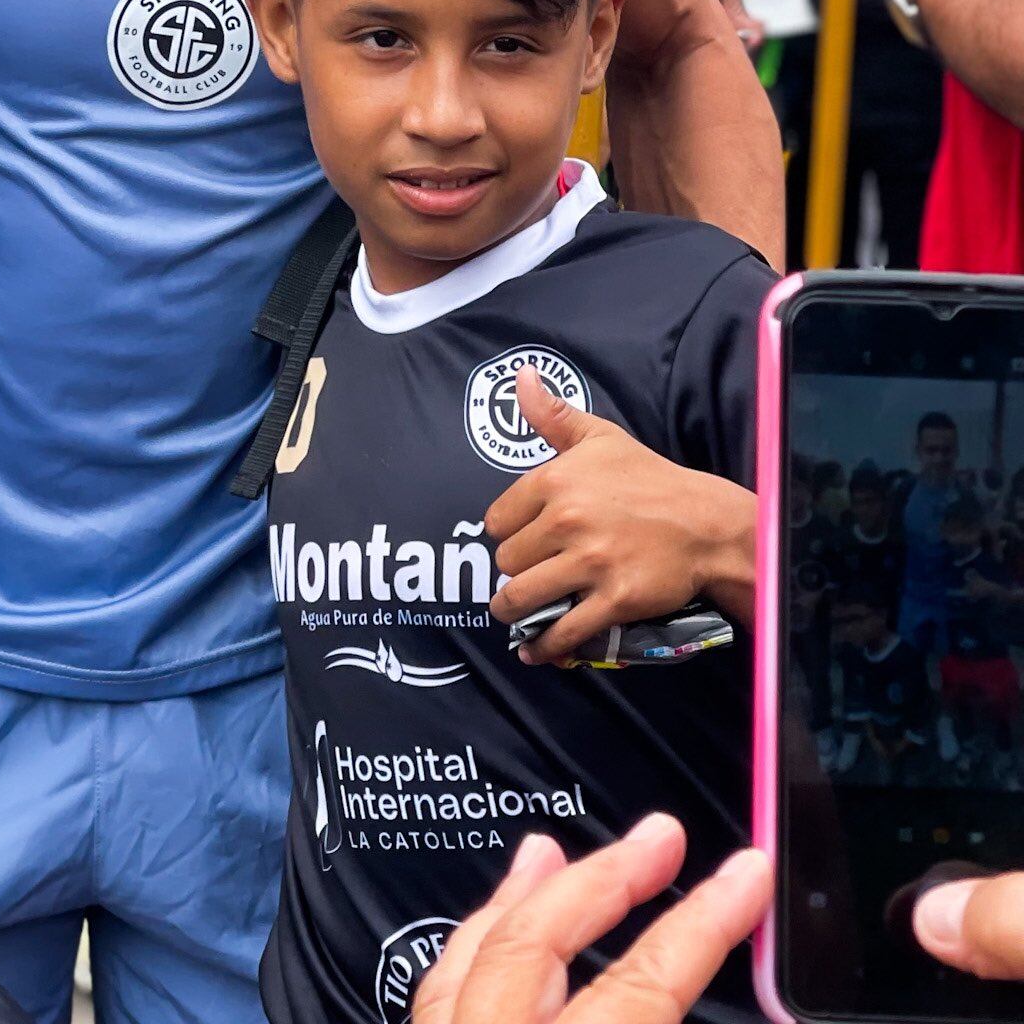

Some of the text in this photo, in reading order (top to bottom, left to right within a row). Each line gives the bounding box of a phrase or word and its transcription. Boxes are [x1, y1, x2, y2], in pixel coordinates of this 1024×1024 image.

[124, 27, 137, 36] 20
[230, 43, 243, 51] 19
[128, 55, 227, 94] FOOTBALL CLUB
[484, 354, 578, 399] SPORTING
[478, 425, 535, 459] FOOTBALL
[269, 520, 514, 603] Montañ
[300, 608, 490, 631] Agua Pura de Manantial
[335, 745, 478, 790] Hospital
[340, 782, 586, 821] Internacional
[348, 831, 370, 849] LA
[384, 955, 413, 1008] TIO
